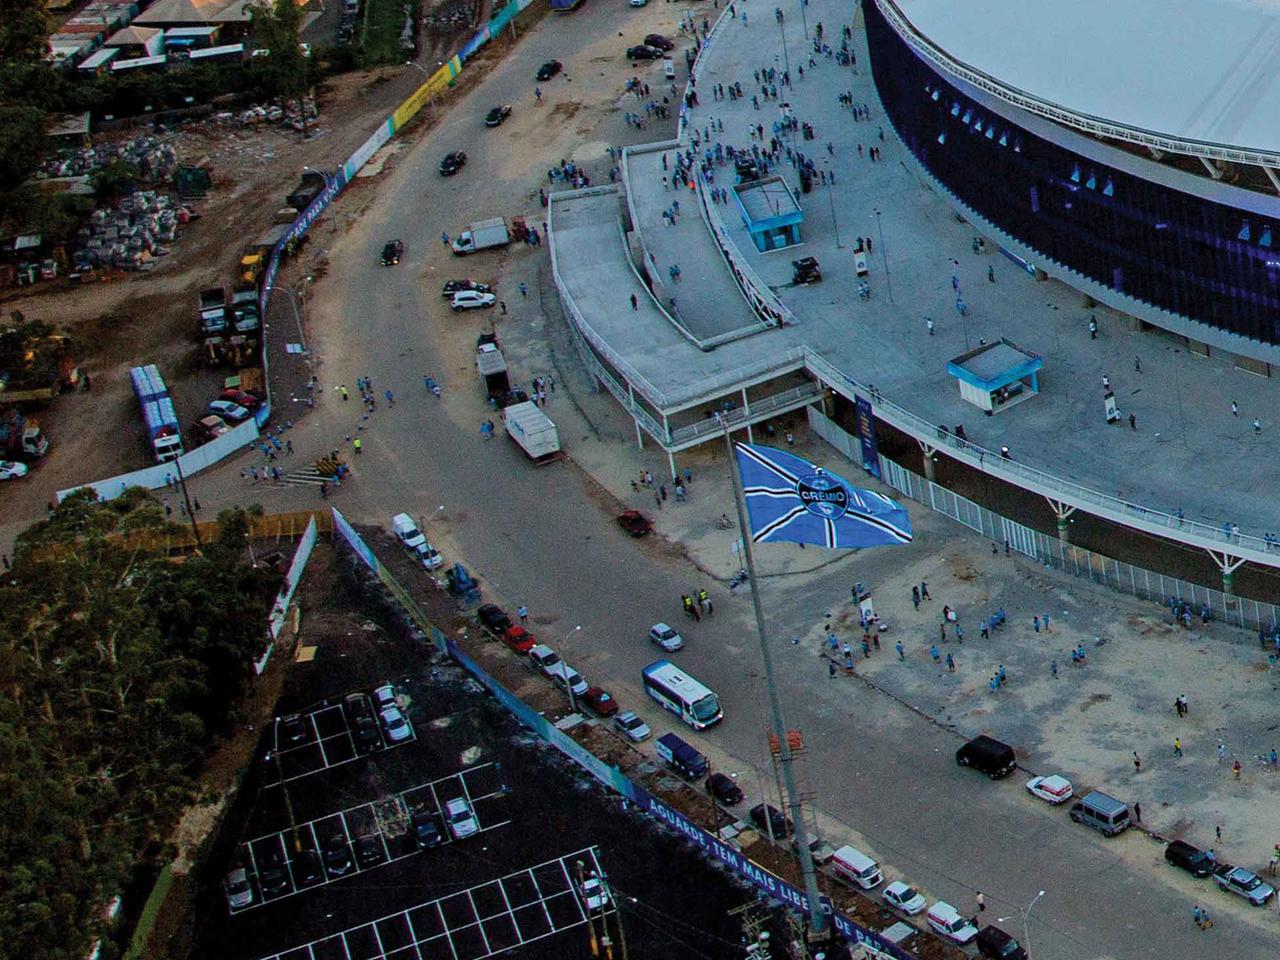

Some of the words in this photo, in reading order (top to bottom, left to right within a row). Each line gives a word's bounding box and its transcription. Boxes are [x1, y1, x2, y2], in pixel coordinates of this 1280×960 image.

[650, 799, 710, 851] AGUARDE,
[712, 841, 738, 868] TEM
[743, 861, 776, 892] MAIS
